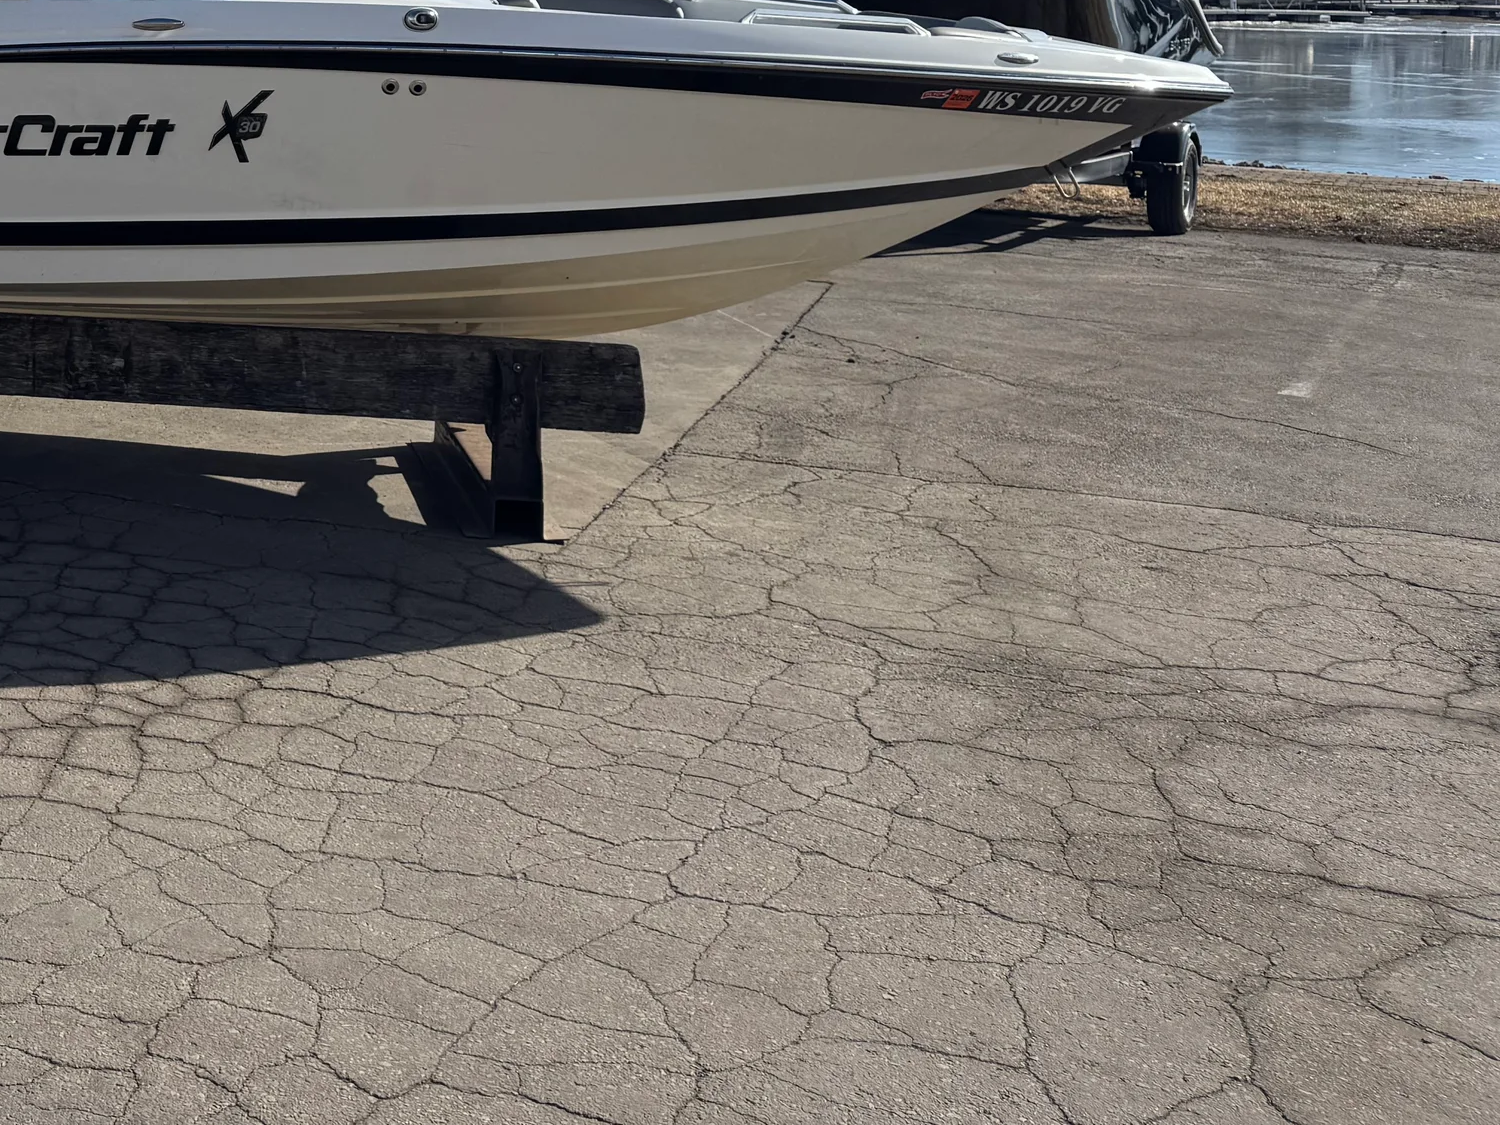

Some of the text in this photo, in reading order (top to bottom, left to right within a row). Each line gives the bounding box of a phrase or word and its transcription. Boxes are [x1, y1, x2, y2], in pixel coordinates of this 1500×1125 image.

[977, 90, 1126, 114] WS 1019 VG
